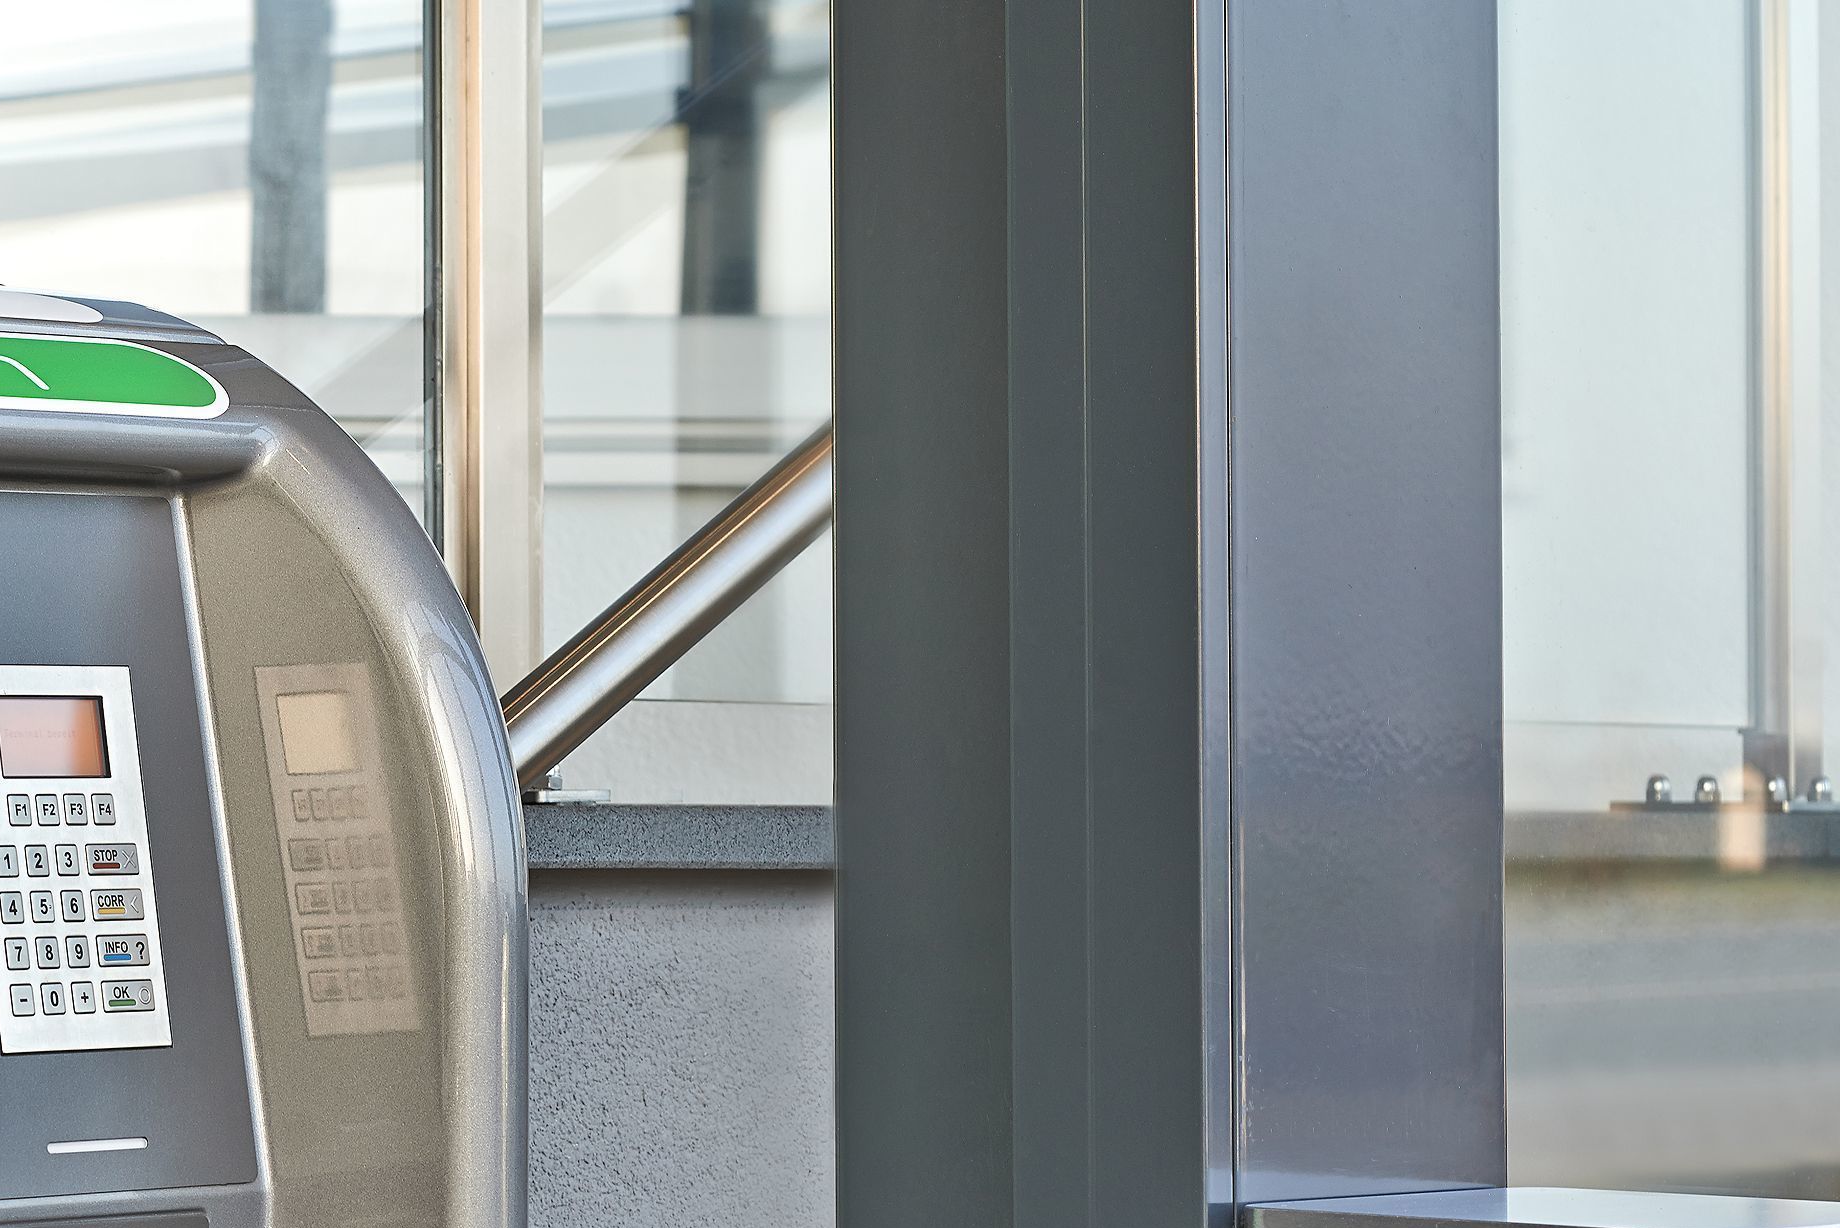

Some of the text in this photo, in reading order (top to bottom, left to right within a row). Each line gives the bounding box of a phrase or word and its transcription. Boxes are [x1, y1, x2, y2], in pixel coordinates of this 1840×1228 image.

[15, 803, 112, 816] F1 F2 F3 F4
[3, 850, 118, 869] 1 2 3 STOP
[9, 895, 124, 916] 4 5 6 CORR
[14, 946, 23, 962] 7
[45, 945, 54, 960] 8
[75, 944, 84, 960] 9
[105, 941, 128, 954] INFO
[50, 990, 59, 1006] 0
[113, 986, 130, 999] OK
